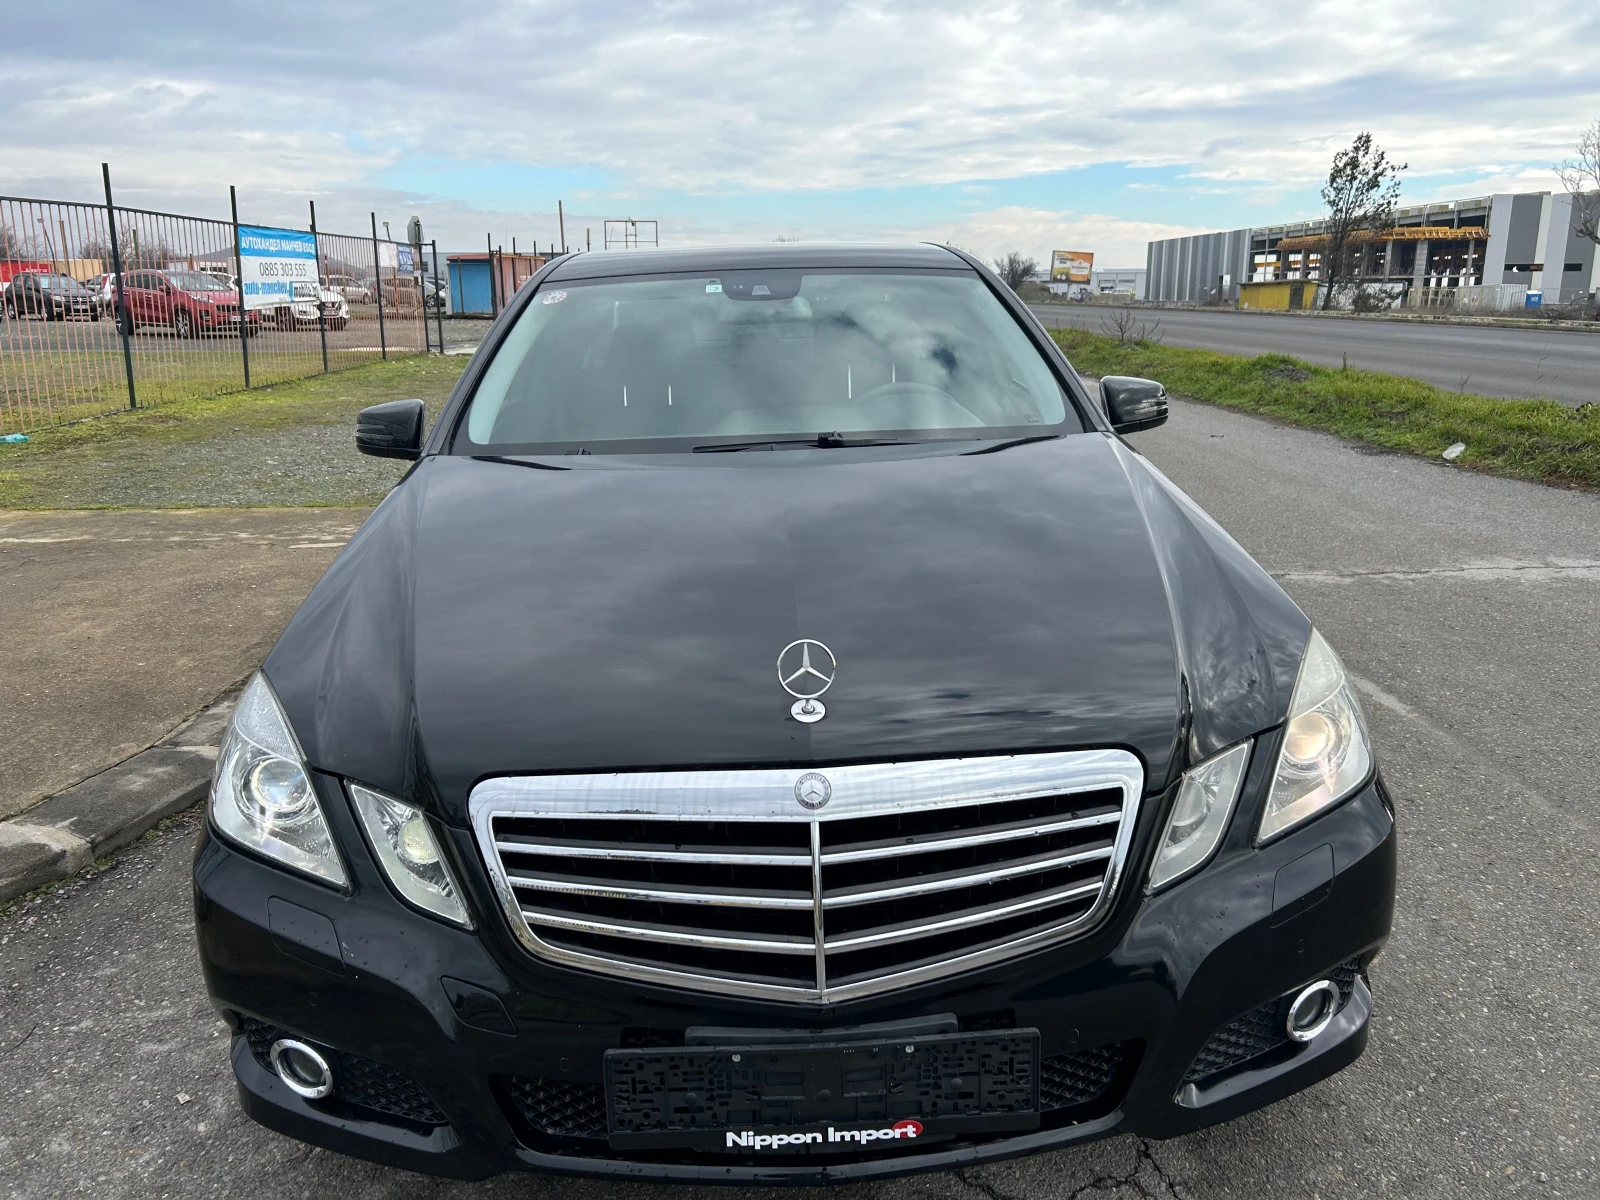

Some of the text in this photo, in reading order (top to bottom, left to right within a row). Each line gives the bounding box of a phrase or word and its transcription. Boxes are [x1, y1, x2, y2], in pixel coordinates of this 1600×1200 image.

[241, 236, 281, 253] АУТОХАНДЕЛ
[281, 239, 302, 253] МАНЧЕВ
[259, 262, 307, 277] 0885 303 555
[726, 1124, 917, 1150] Nippon Import
